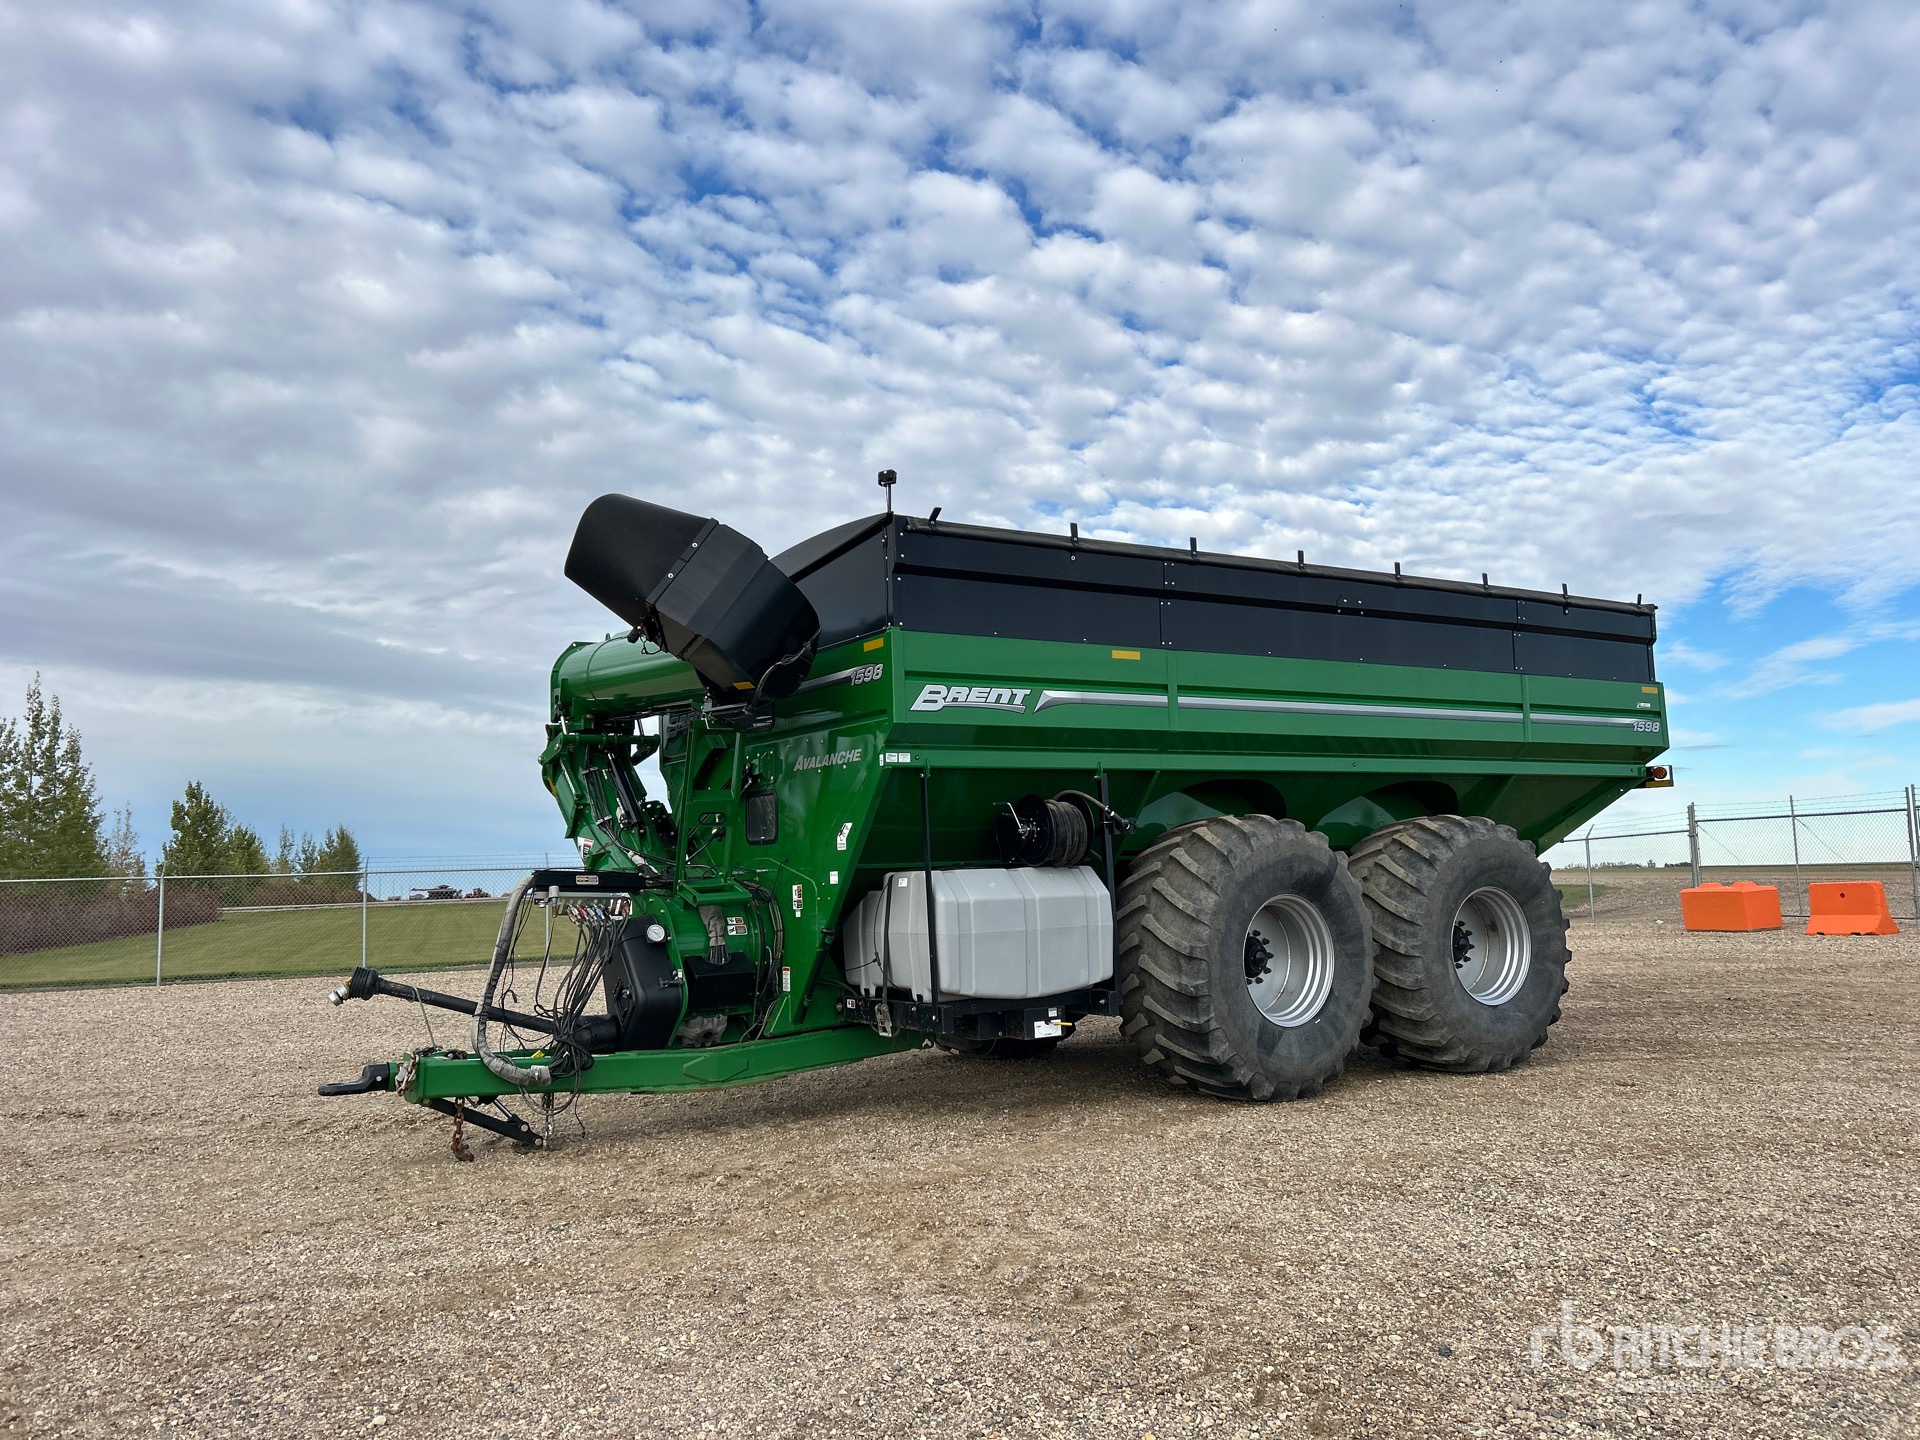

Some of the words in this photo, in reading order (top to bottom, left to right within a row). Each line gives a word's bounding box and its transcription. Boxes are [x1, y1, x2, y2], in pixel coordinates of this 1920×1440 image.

[850, 664, 884, 686] 1598
[910, 684, 1032, 713] BRENT
[1633, 720, 1660, 733] 1598
[793, 749, 862, 771] AVALANCHE
